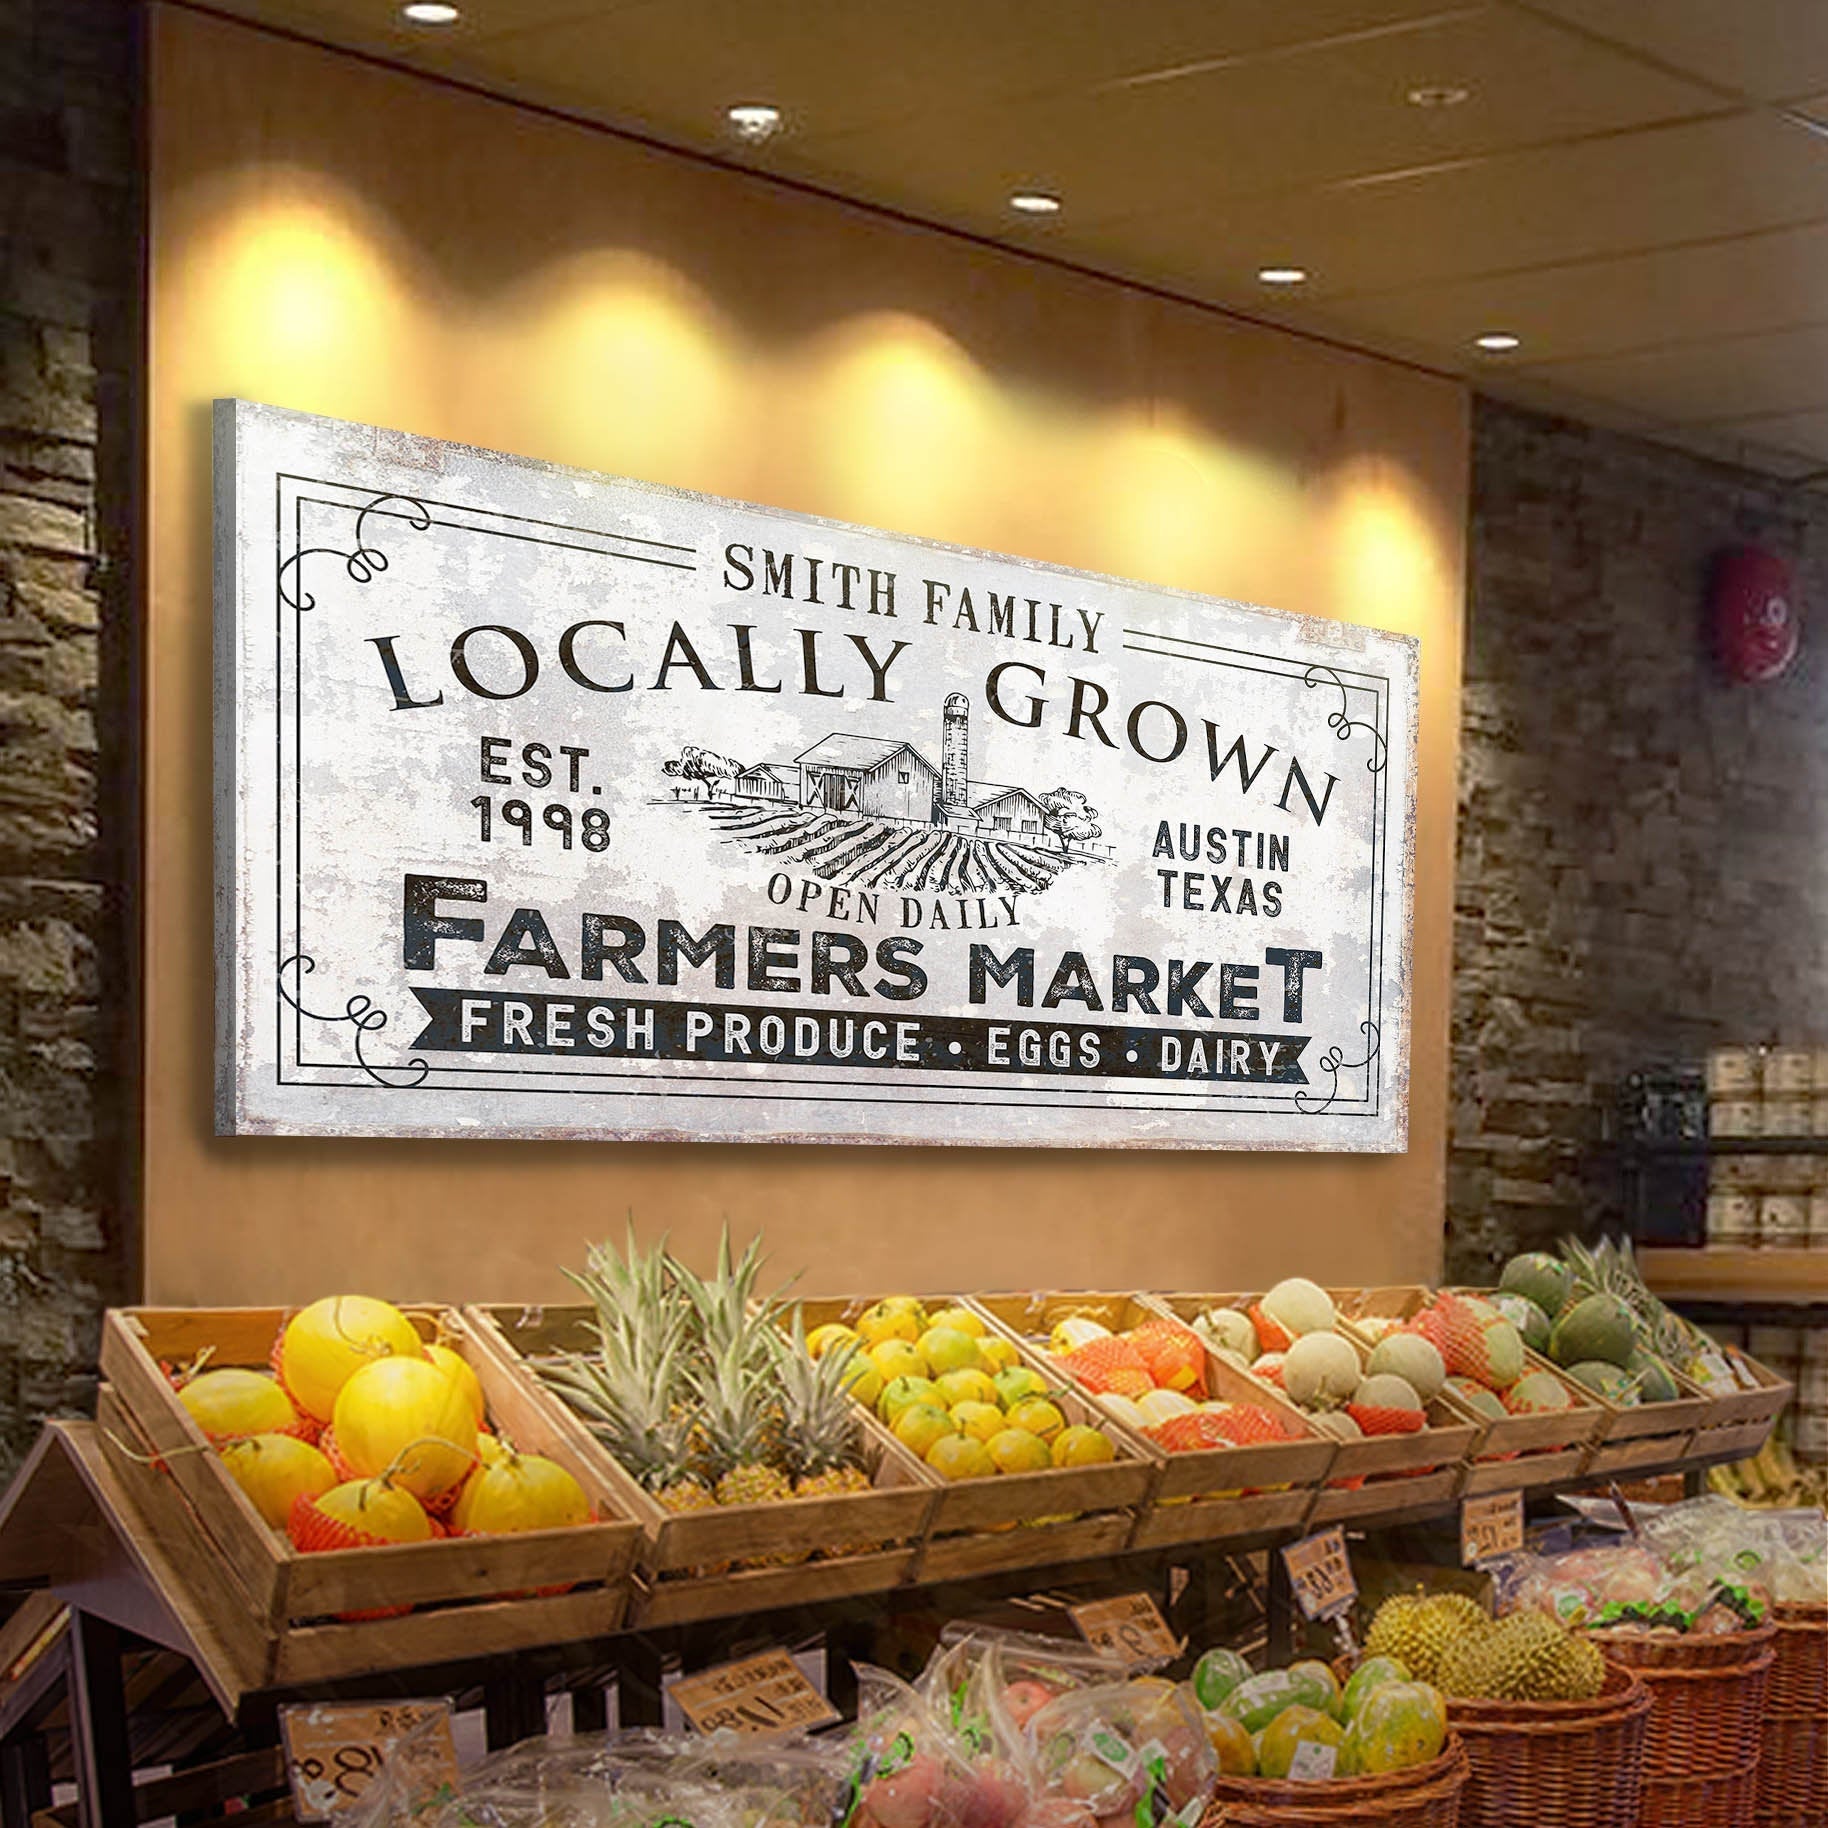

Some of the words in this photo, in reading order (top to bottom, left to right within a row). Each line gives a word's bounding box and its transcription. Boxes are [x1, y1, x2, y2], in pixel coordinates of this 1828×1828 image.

[724, 544, 897, 617] SMITH
[923, 580, 1104, 653] FAMILY
[364, 620, 913, 712] LOCALLY
[986, 662, 1340, 826] GROWN
[481, 736, 601, 795] EST.
[471, 796, 610, 852] 1998
[1152, 821, 1289, 872] AUSTIN
[768, 873, 879, 924] OPEN
[901, 895, 1020, 929] DAILY
[1158, 869, 1282, 917] TEXAS
[403, 873, 927, 1000] FARMERS
[969, 944, 1322, 1023] MARKET
[462, 999, 653, 1049] FRESH
[687, 1011, 919, 1061] PRODUCE
[989, 1027, 1100, 1068] EGGS
[1162, 1036, 1280, 1075] DAIRY
